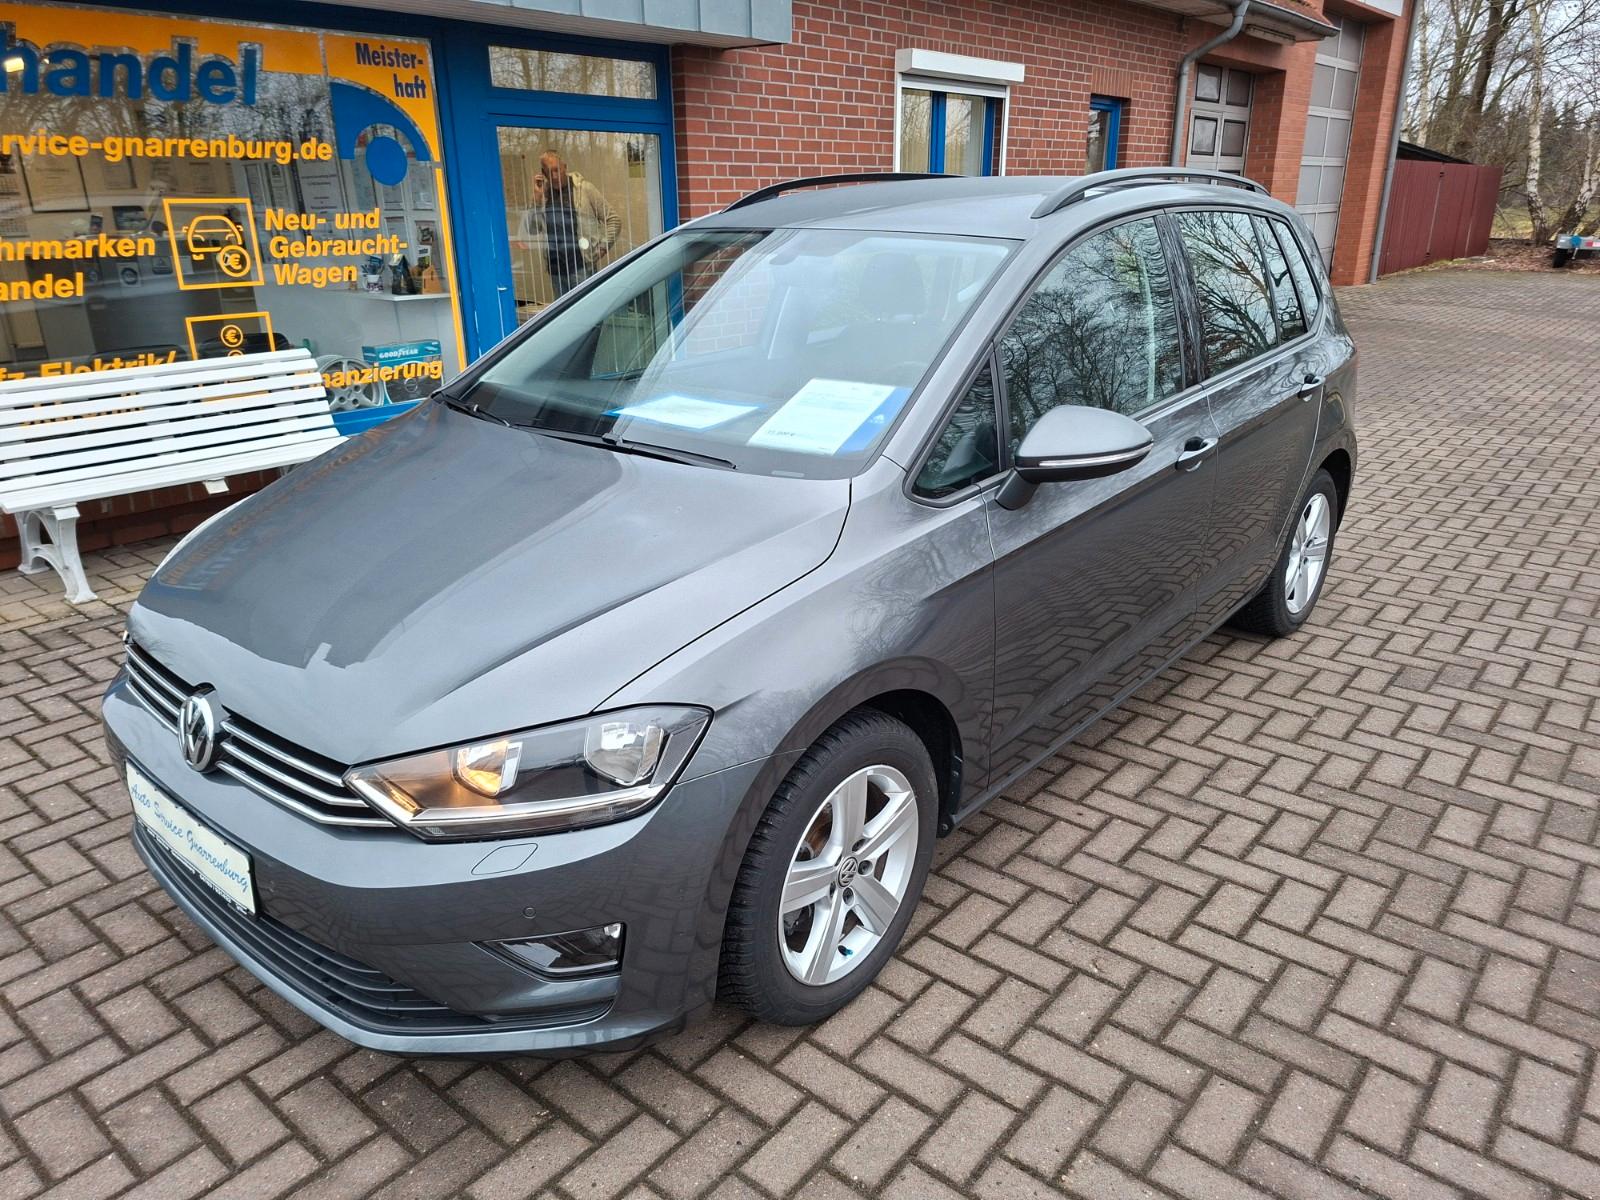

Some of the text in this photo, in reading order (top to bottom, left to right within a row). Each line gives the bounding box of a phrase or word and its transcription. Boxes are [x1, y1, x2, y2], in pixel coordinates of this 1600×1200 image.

[355, 42, 424, 69] Meister-
[393, 73, 427, 99] haft
[265, 207, 380, 231] Neu- und
[269, 234, 407, 259] Gebraucht-
[274, 264, 357, 288] Wagen
[131, 784, 151, 808] Auto
[154, 801, 184, 840] Service
